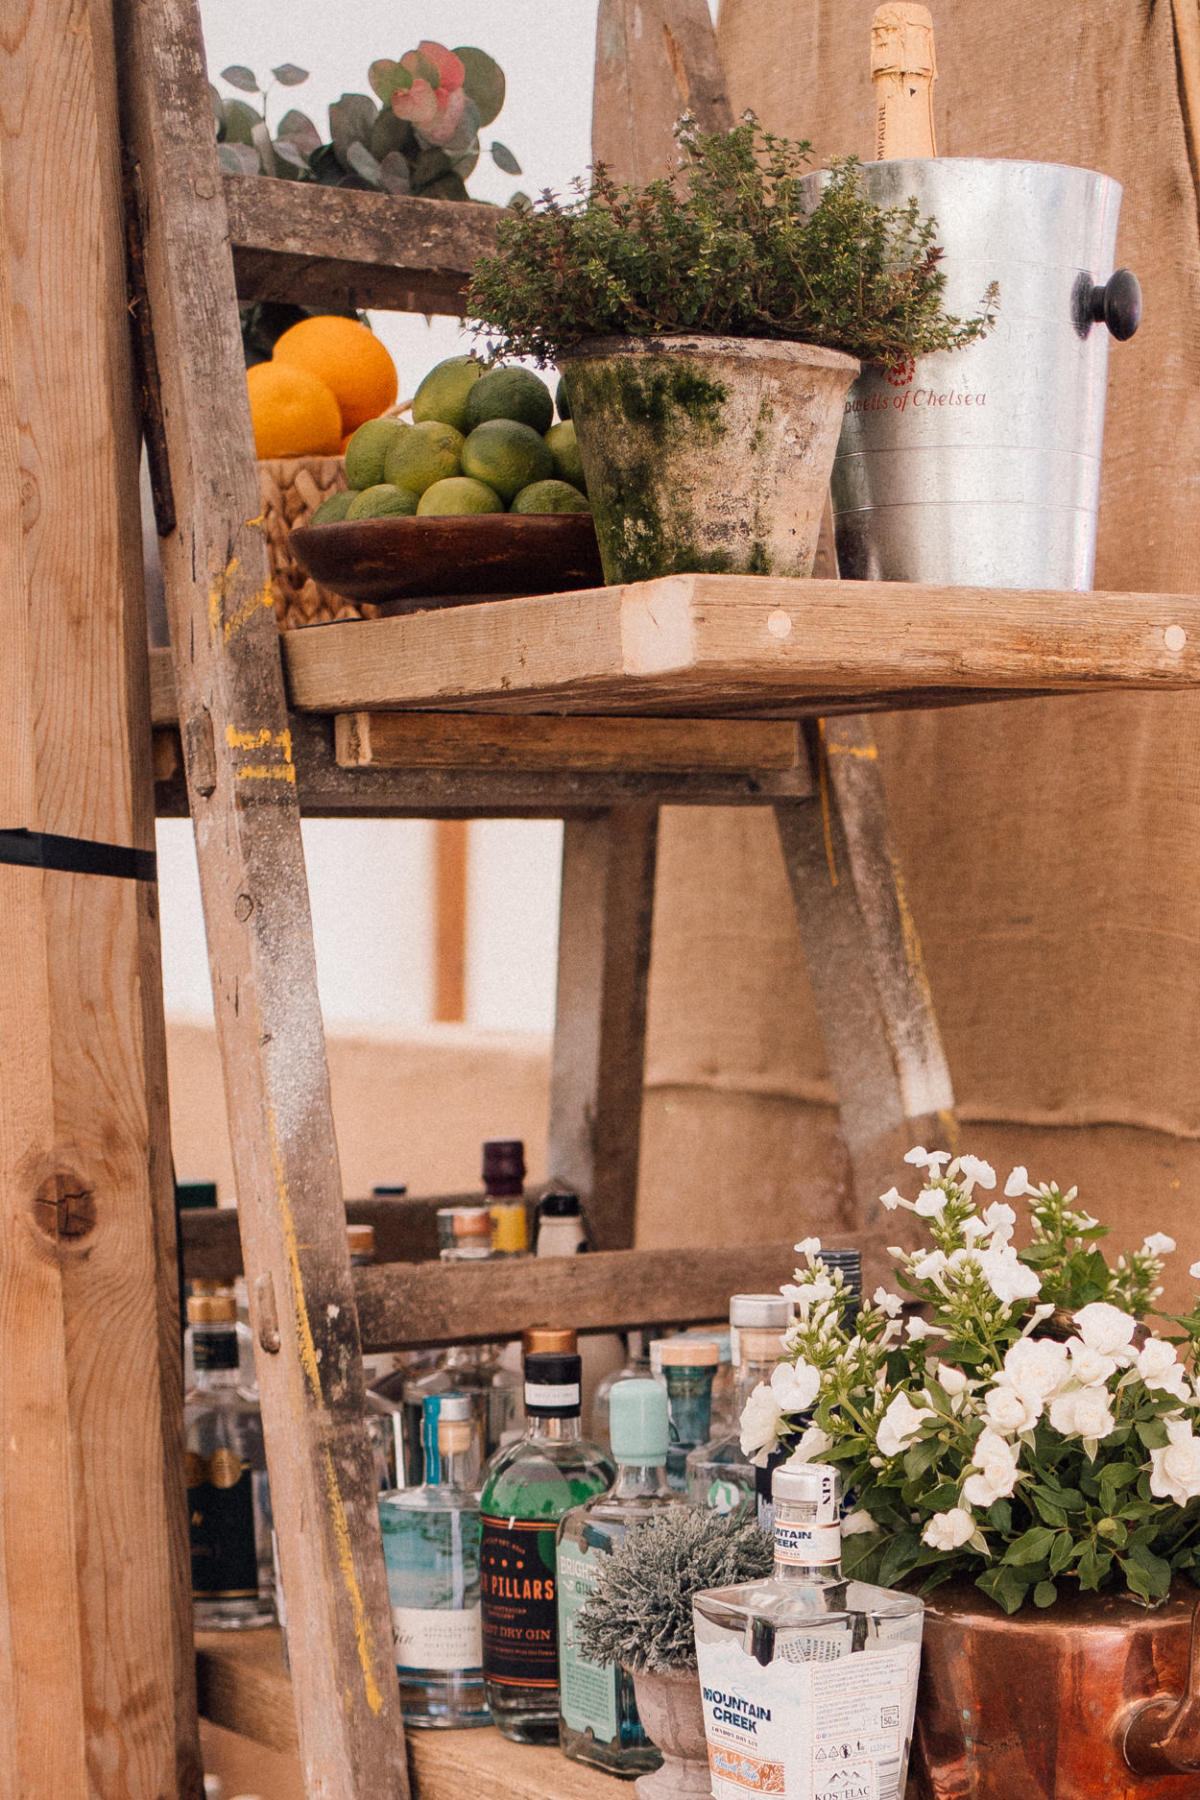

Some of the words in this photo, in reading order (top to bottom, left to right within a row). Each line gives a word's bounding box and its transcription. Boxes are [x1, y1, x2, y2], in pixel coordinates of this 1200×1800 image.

[892, 390, 912, 412] of
[912, 389, 987, 408] Chelsea
[822, 1477, 831, 1505] GIN
[491, 1575, 555, 1600] PILLARS
[499, 1626, 523, 1640] DRY
[525, 1628, 551, 1641] GIN
[703, 1687, 771, 1722] MOUNTAIN
[713, 1706, 758, 1734] CREEK
